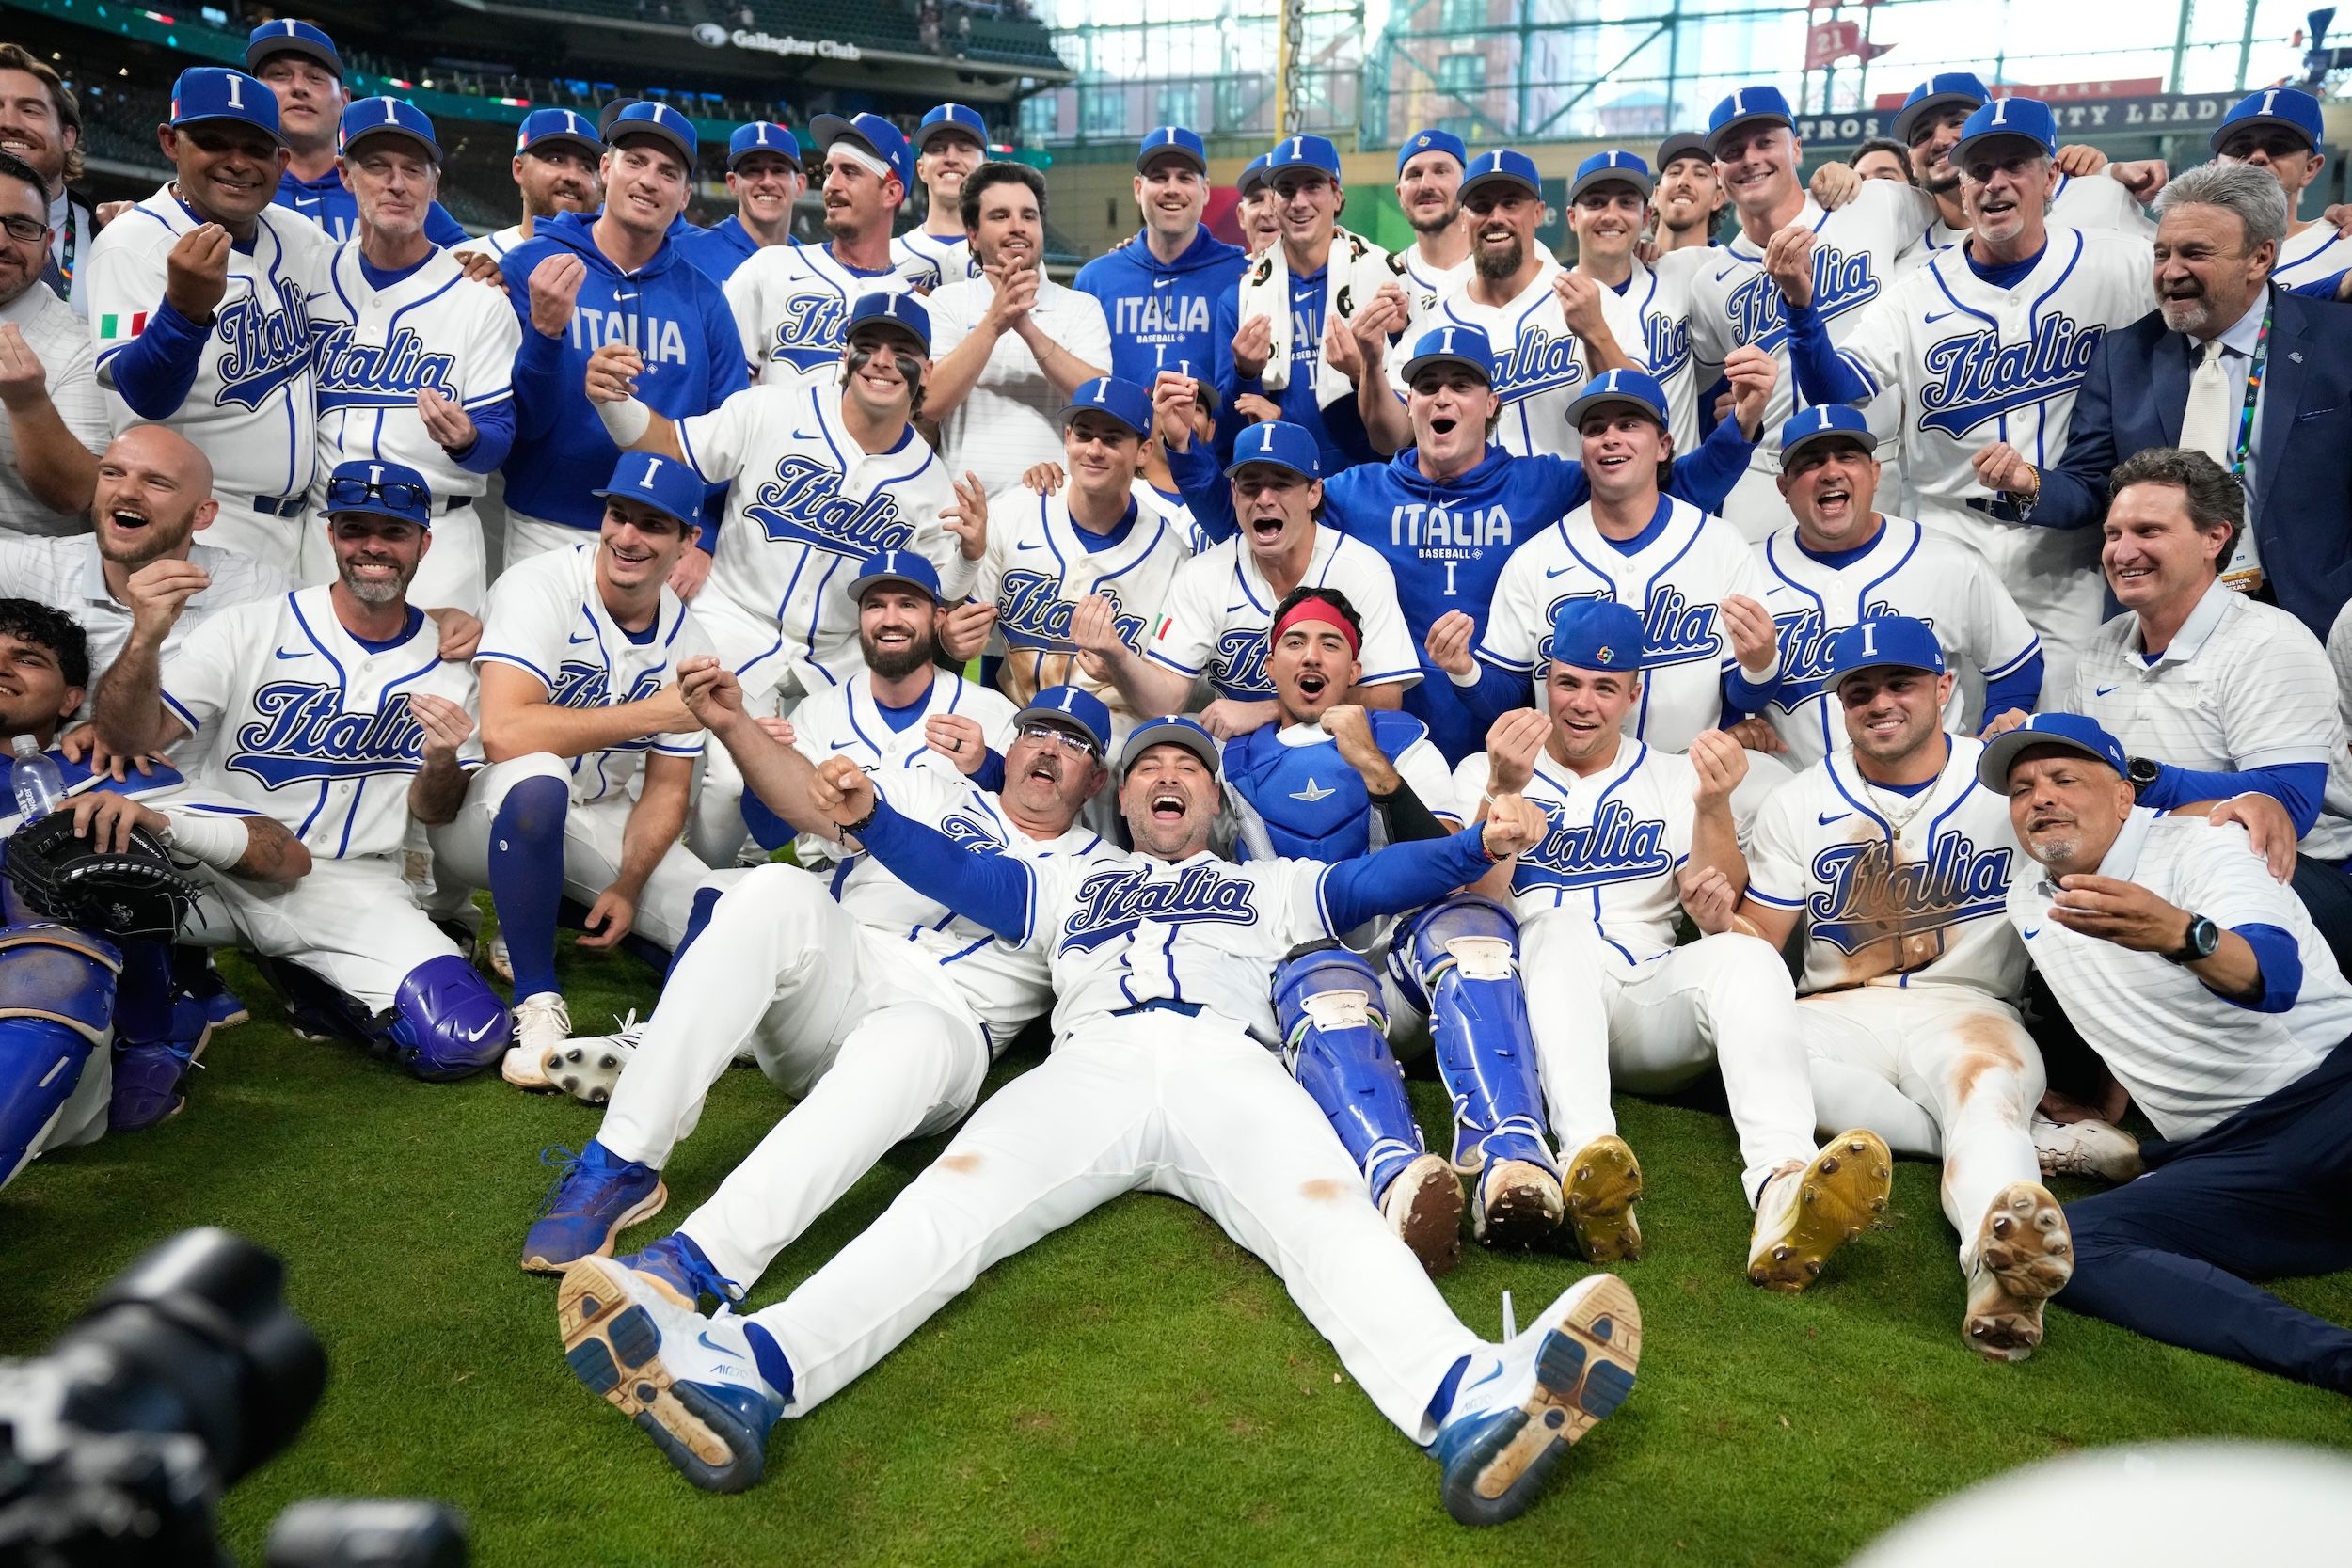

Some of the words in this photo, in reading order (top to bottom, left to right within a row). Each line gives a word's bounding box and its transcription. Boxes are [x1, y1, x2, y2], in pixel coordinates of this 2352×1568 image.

[731, 29, 816, 56] Gallagher
[817, 40, 861, 61] Club
[1816, 29, 1844, 54] 21
[2038, 81, 2112, 98] PARK
[1797, 118, 1879, 141] TROS
[2055, 105, 2110, 126] ITY
[1116, 296, 1210, 334] ITALIA
[1725, 244, 1881, 348] Itlia
[217, 277, 310, 384] Itali
[572, 307, 686, 364] ITALIA
[1136, 334, 1175, 343] BASEBALL
[1647, 311, 1692, 373] lia
[310, 319, 458, 401] Italia
[1493, 325, 1583, 393] alia
[1920, 311, 2106, 409] Italia
[757, 454, 917, 552] Italia
[1391, 503, 1512, 546] ITALIA
[1418, 548, 1470, 559] BASEBALL
[1443, 561, 1458, 596] I
[24, 787, 38, 812] water
[1518, 798, 1674, 877] talia
[1064, 867, 1258, 934] Italia
[1808, 830, 2013, 922] Italia
